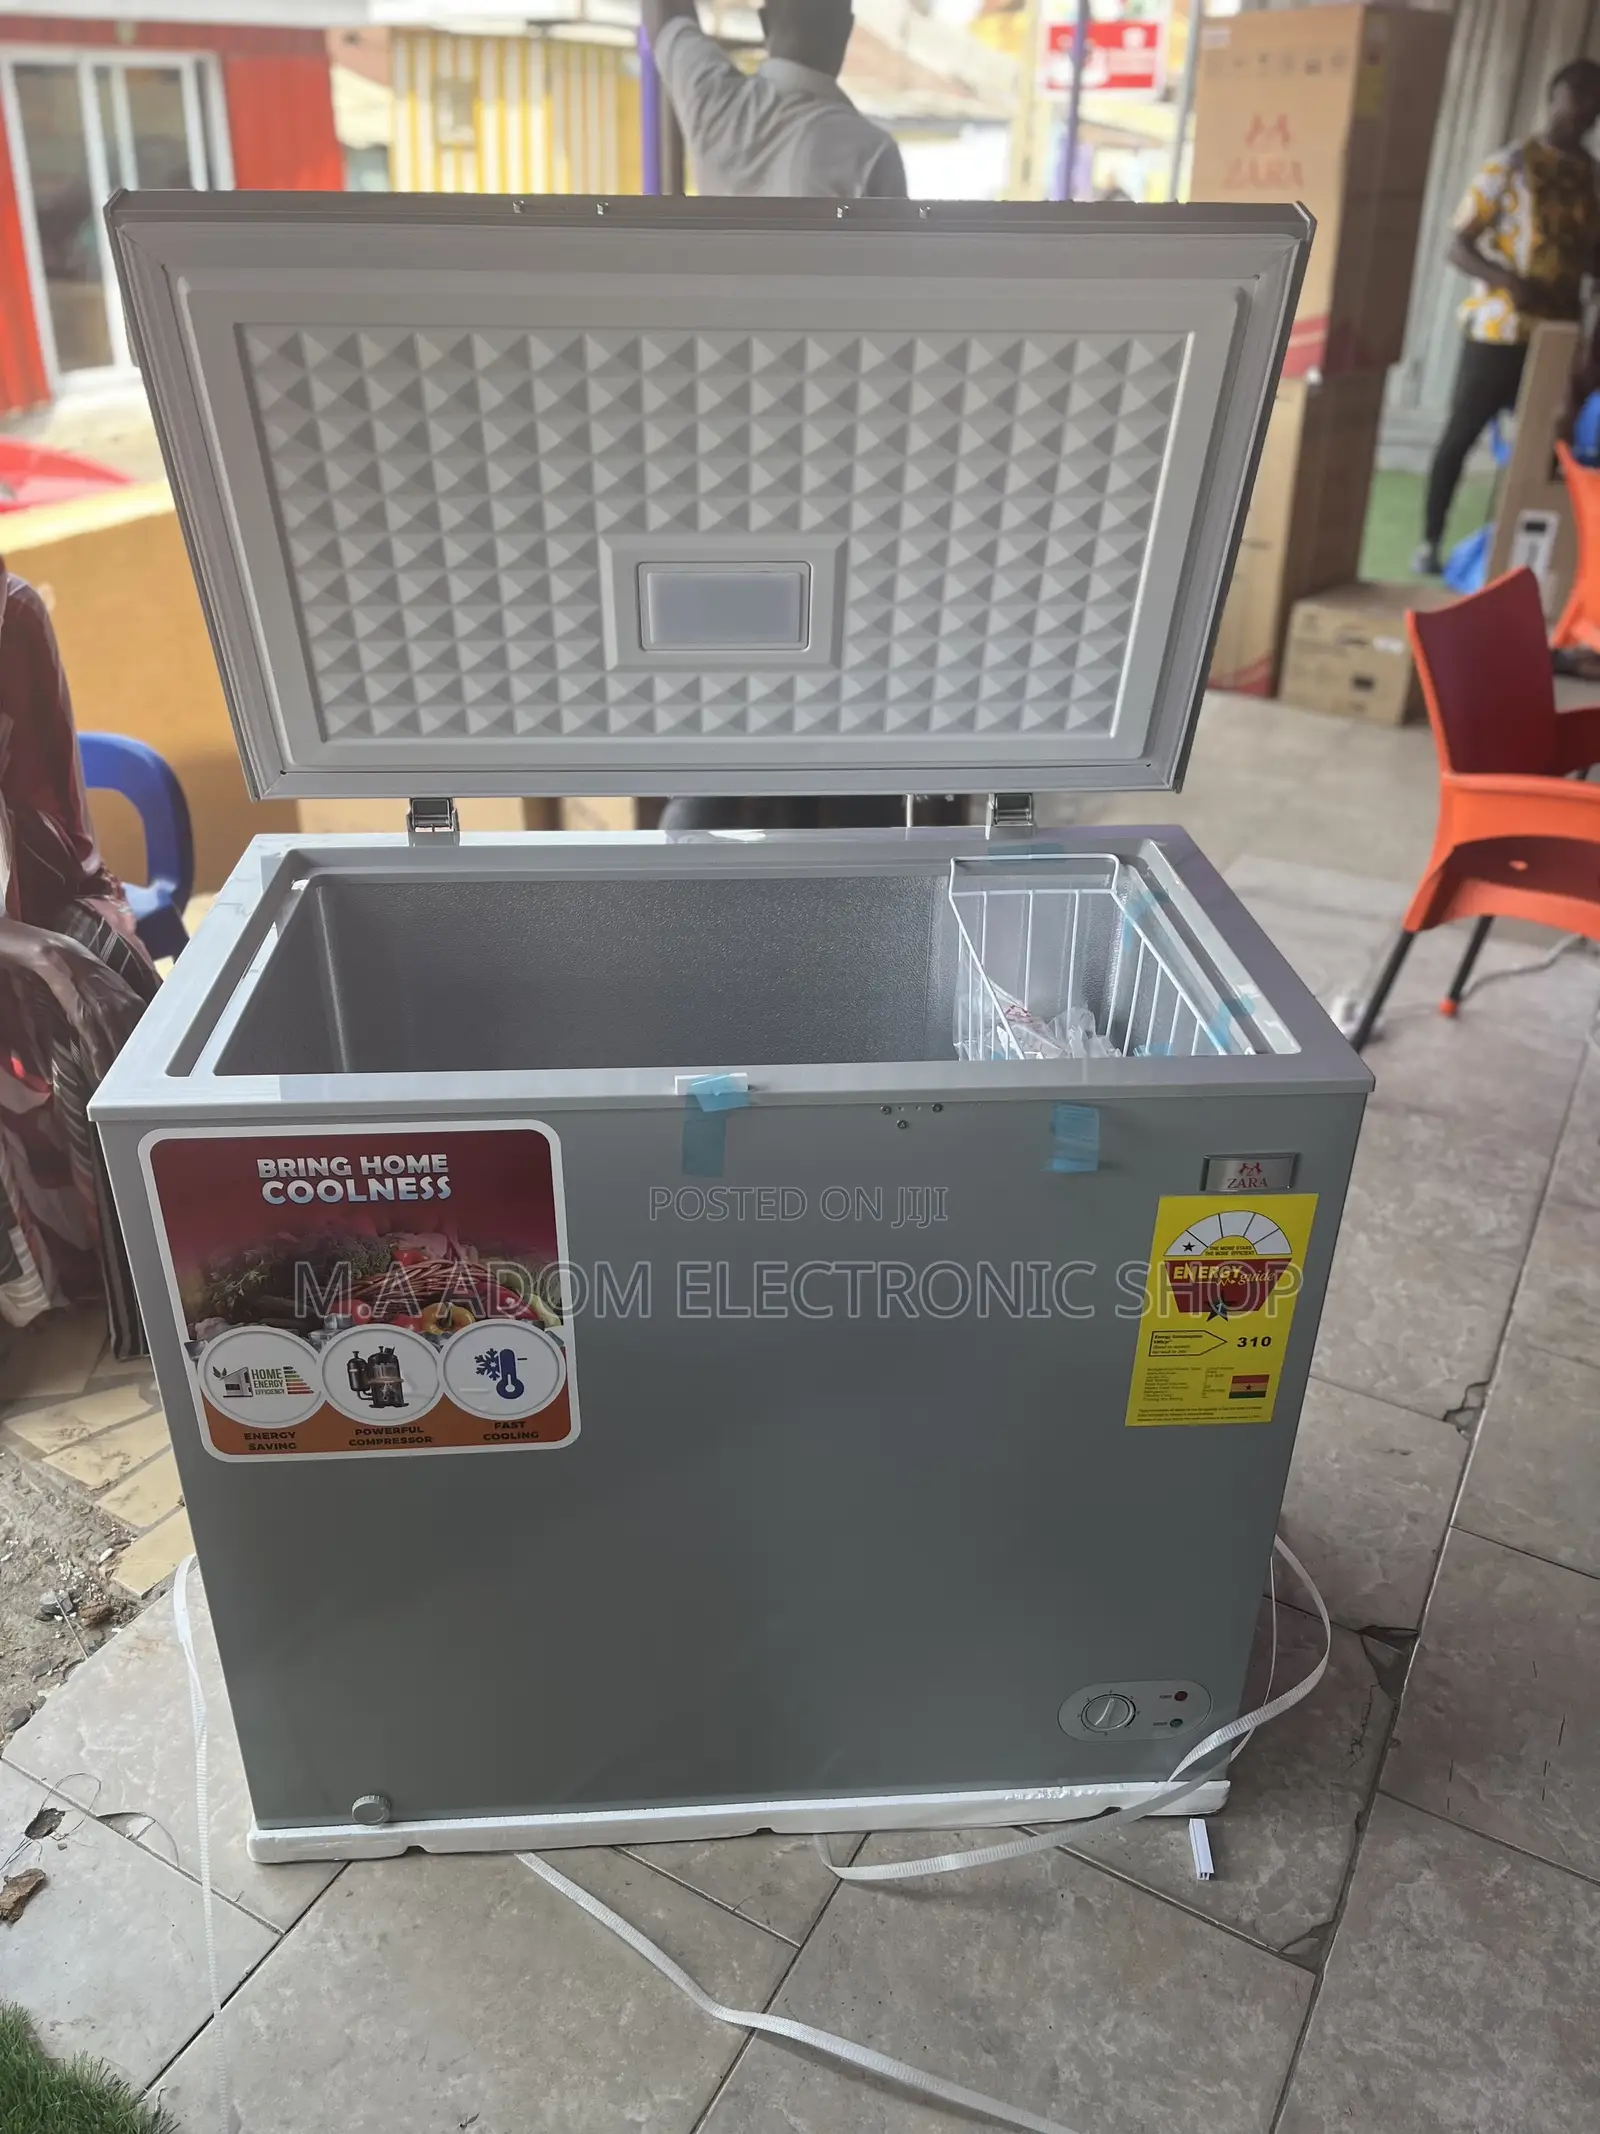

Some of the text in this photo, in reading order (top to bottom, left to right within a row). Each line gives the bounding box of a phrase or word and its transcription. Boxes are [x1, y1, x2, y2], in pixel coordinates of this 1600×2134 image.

[256, 1153, 449, 1178] BRING HOME
[1227, 1177, 1268, 1188] ZARA
[261, 1175, 452, 1205] COOLNESS
[1173, 1262, 1277, 1286] ENERGY guide
[1236, 1336, 1272, 1348] 310
[251, 1368, 283, 1380] HOME
[253, 1379, 284, 1389] ENERGY
[255, 1388, 286, 1396] EFFICIENCY
[494, 1421, 527, 1430] FAST
[244, 1431, 297, 1441] ENERGY
[355, 1426, 424, 1436] POWERFUL
[483, 1431, 540, 1441] COOLING
[248, 1442, 297, 1451] SAVING
[349, 1436, 434, 1447] COMPRESSOR
